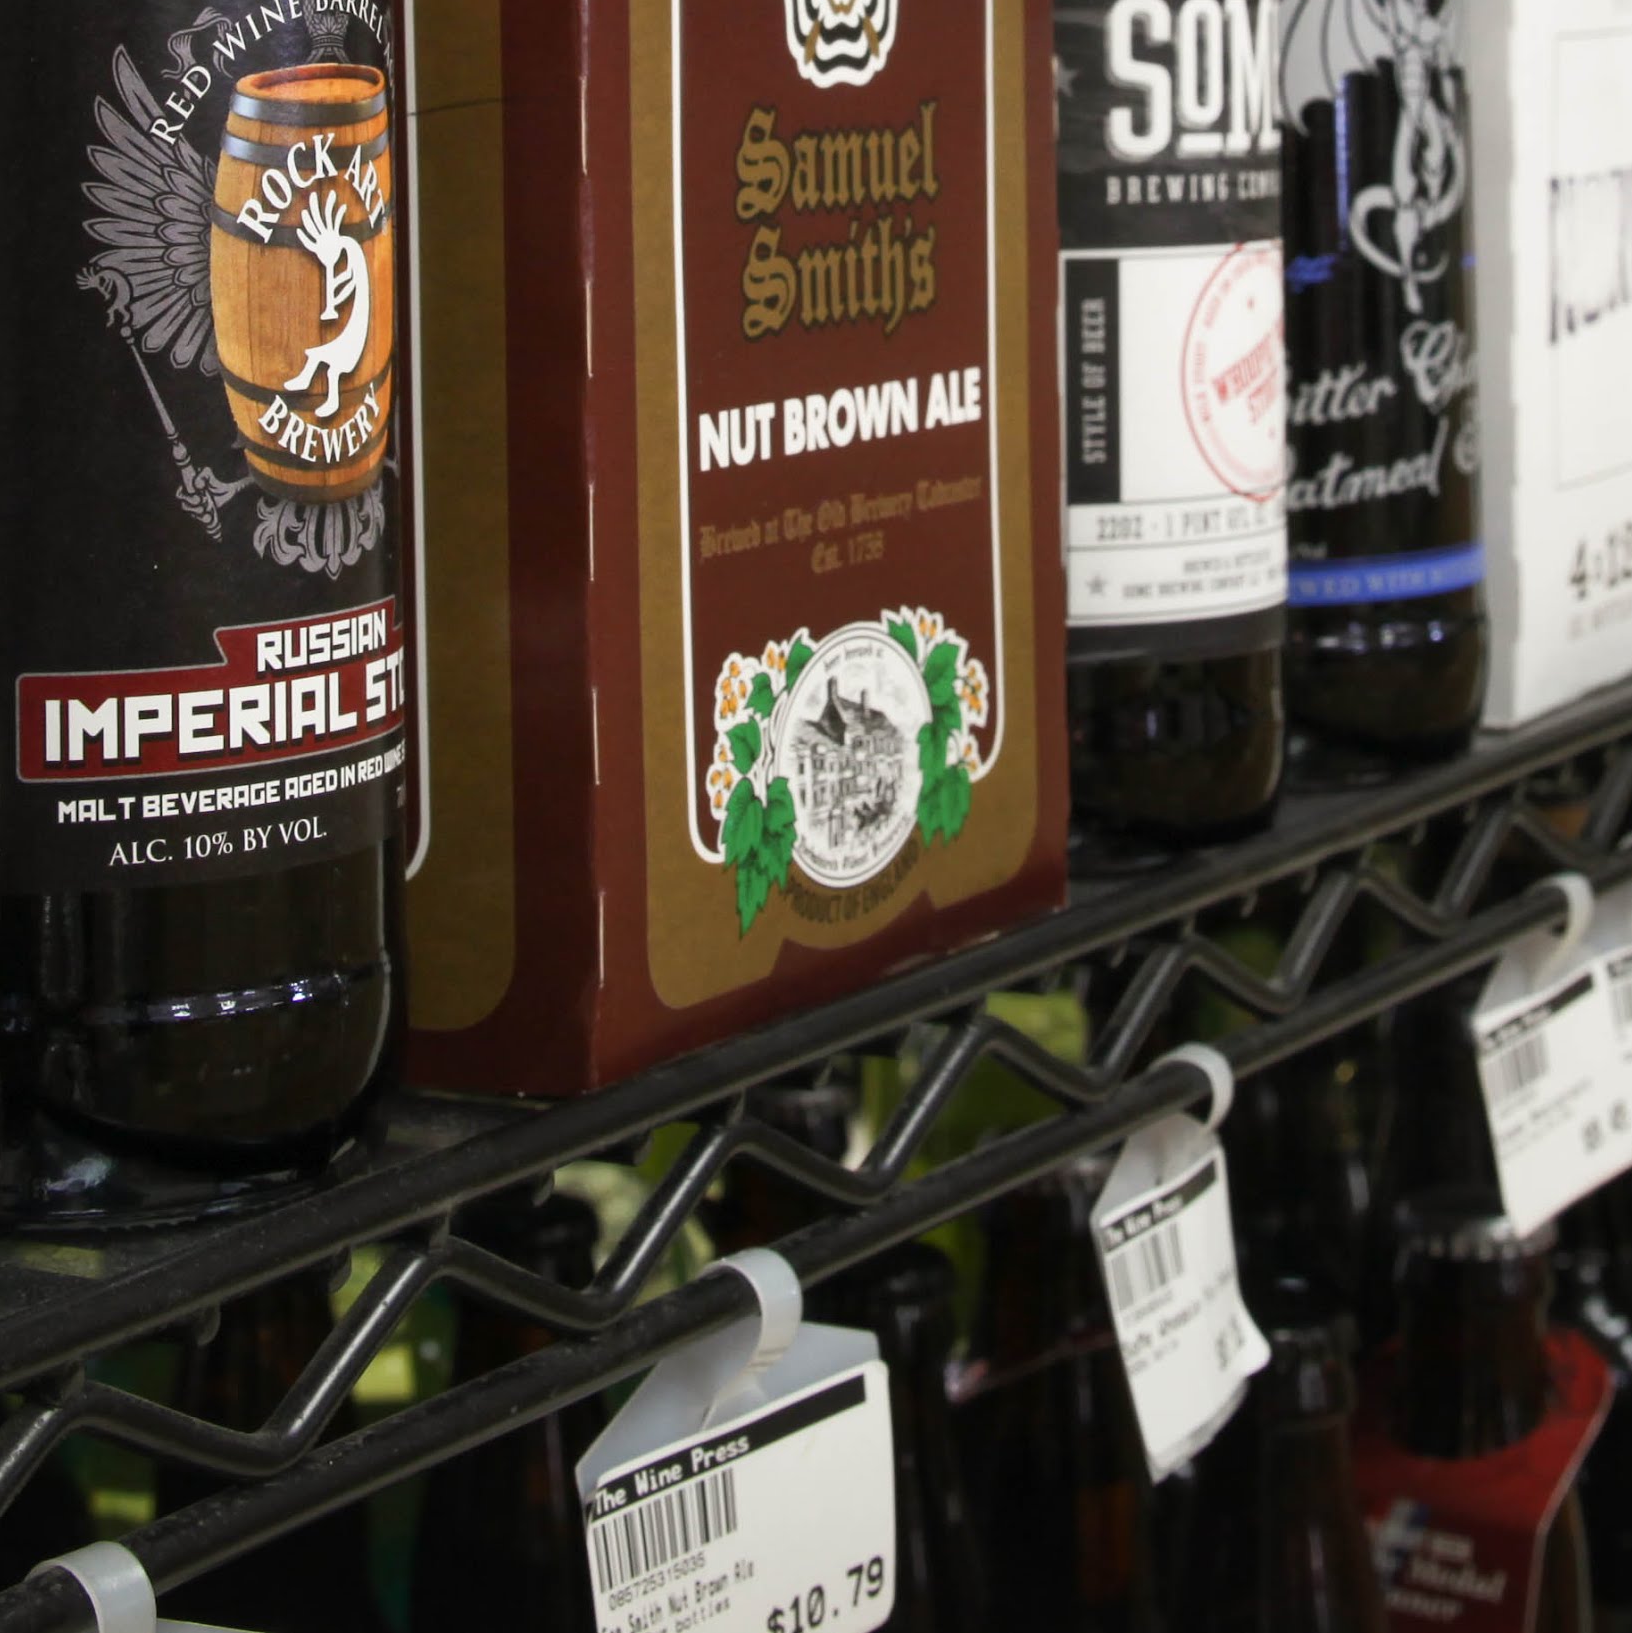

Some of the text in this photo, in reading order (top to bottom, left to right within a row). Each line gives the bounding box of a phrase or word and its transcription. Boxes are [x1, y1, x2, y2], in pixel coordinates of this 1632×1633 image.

[149, 64, 213, 149] RED
[236, 131, 339, 244] ROCK
[735, 99, 940, 221] Samuel
[1105, 173, 1230, 206] BREWING
[741, 216, 937, 341] Smith's
[257, 383, 380, 465] BREWERY
[698, 367, 982, 472] NUT BROWN ALE
[256, 607, 387, 673] RUSSIAN
[44, 671, 358, 763] IMPERIAL
[57, 796, 137, 824] MALT
[142, 780, 281, 818] BEVERAGE
[284, 768, 339, 801] AGED
[340, 763, 356, 789] IN
[357, 754, 384, 784] RED
[108, 816, 328, 868] ALC. 10% BY VOL.
[595, 1435, 750, 1516] The Wine Press
[766, 1555, 885, 1633] $10.79
